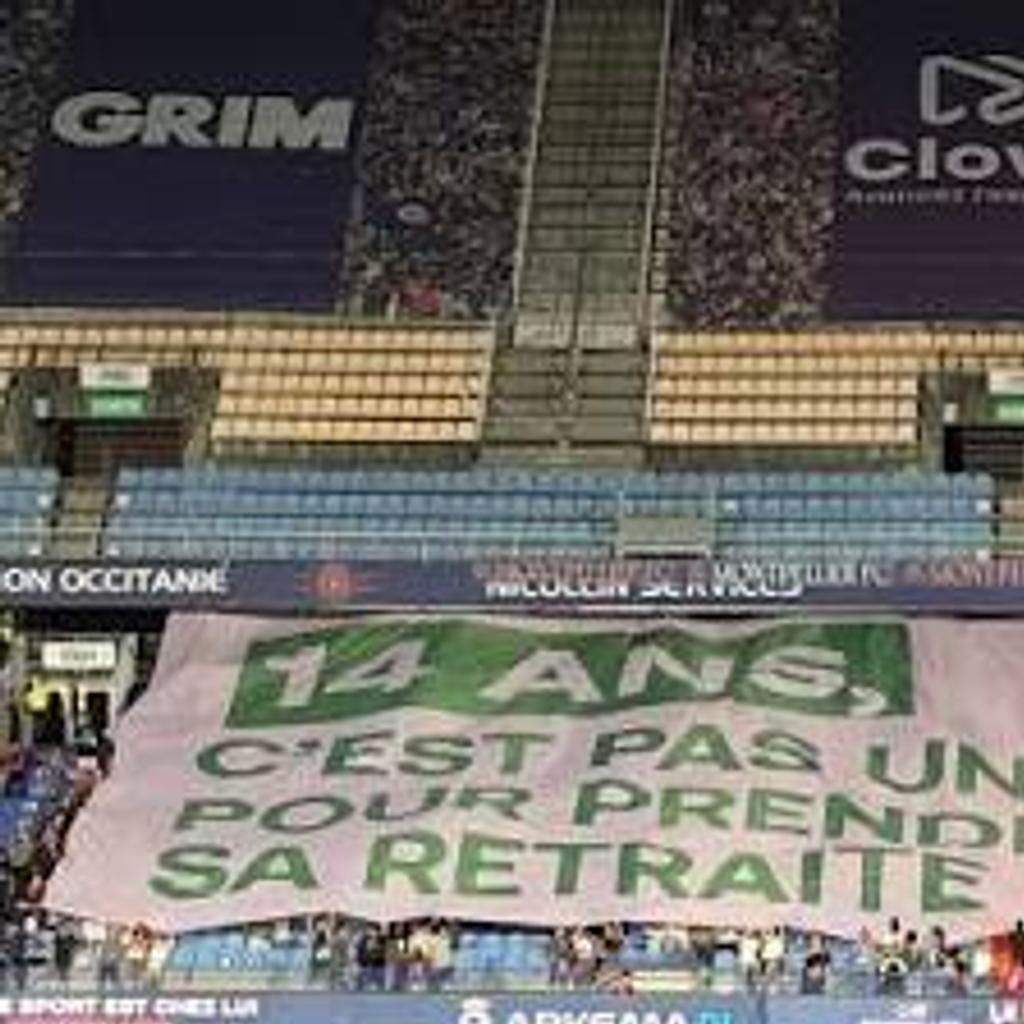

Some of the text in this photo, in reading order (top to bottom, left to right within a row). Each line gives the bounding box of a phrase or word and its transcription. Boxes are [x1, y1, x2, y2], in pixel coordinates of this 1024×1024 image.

[50, 91, 356, 149] GRIM
[266, 640, 886, 717] 14 ANS,
[198, 731, 551, 779] C'EST
[591, 724, 823, 772] PAS
[174, 786, 531, 833] POUR
[149, 844, 321, 899] SA
[364, 832, 989, 914] RETRAITE
